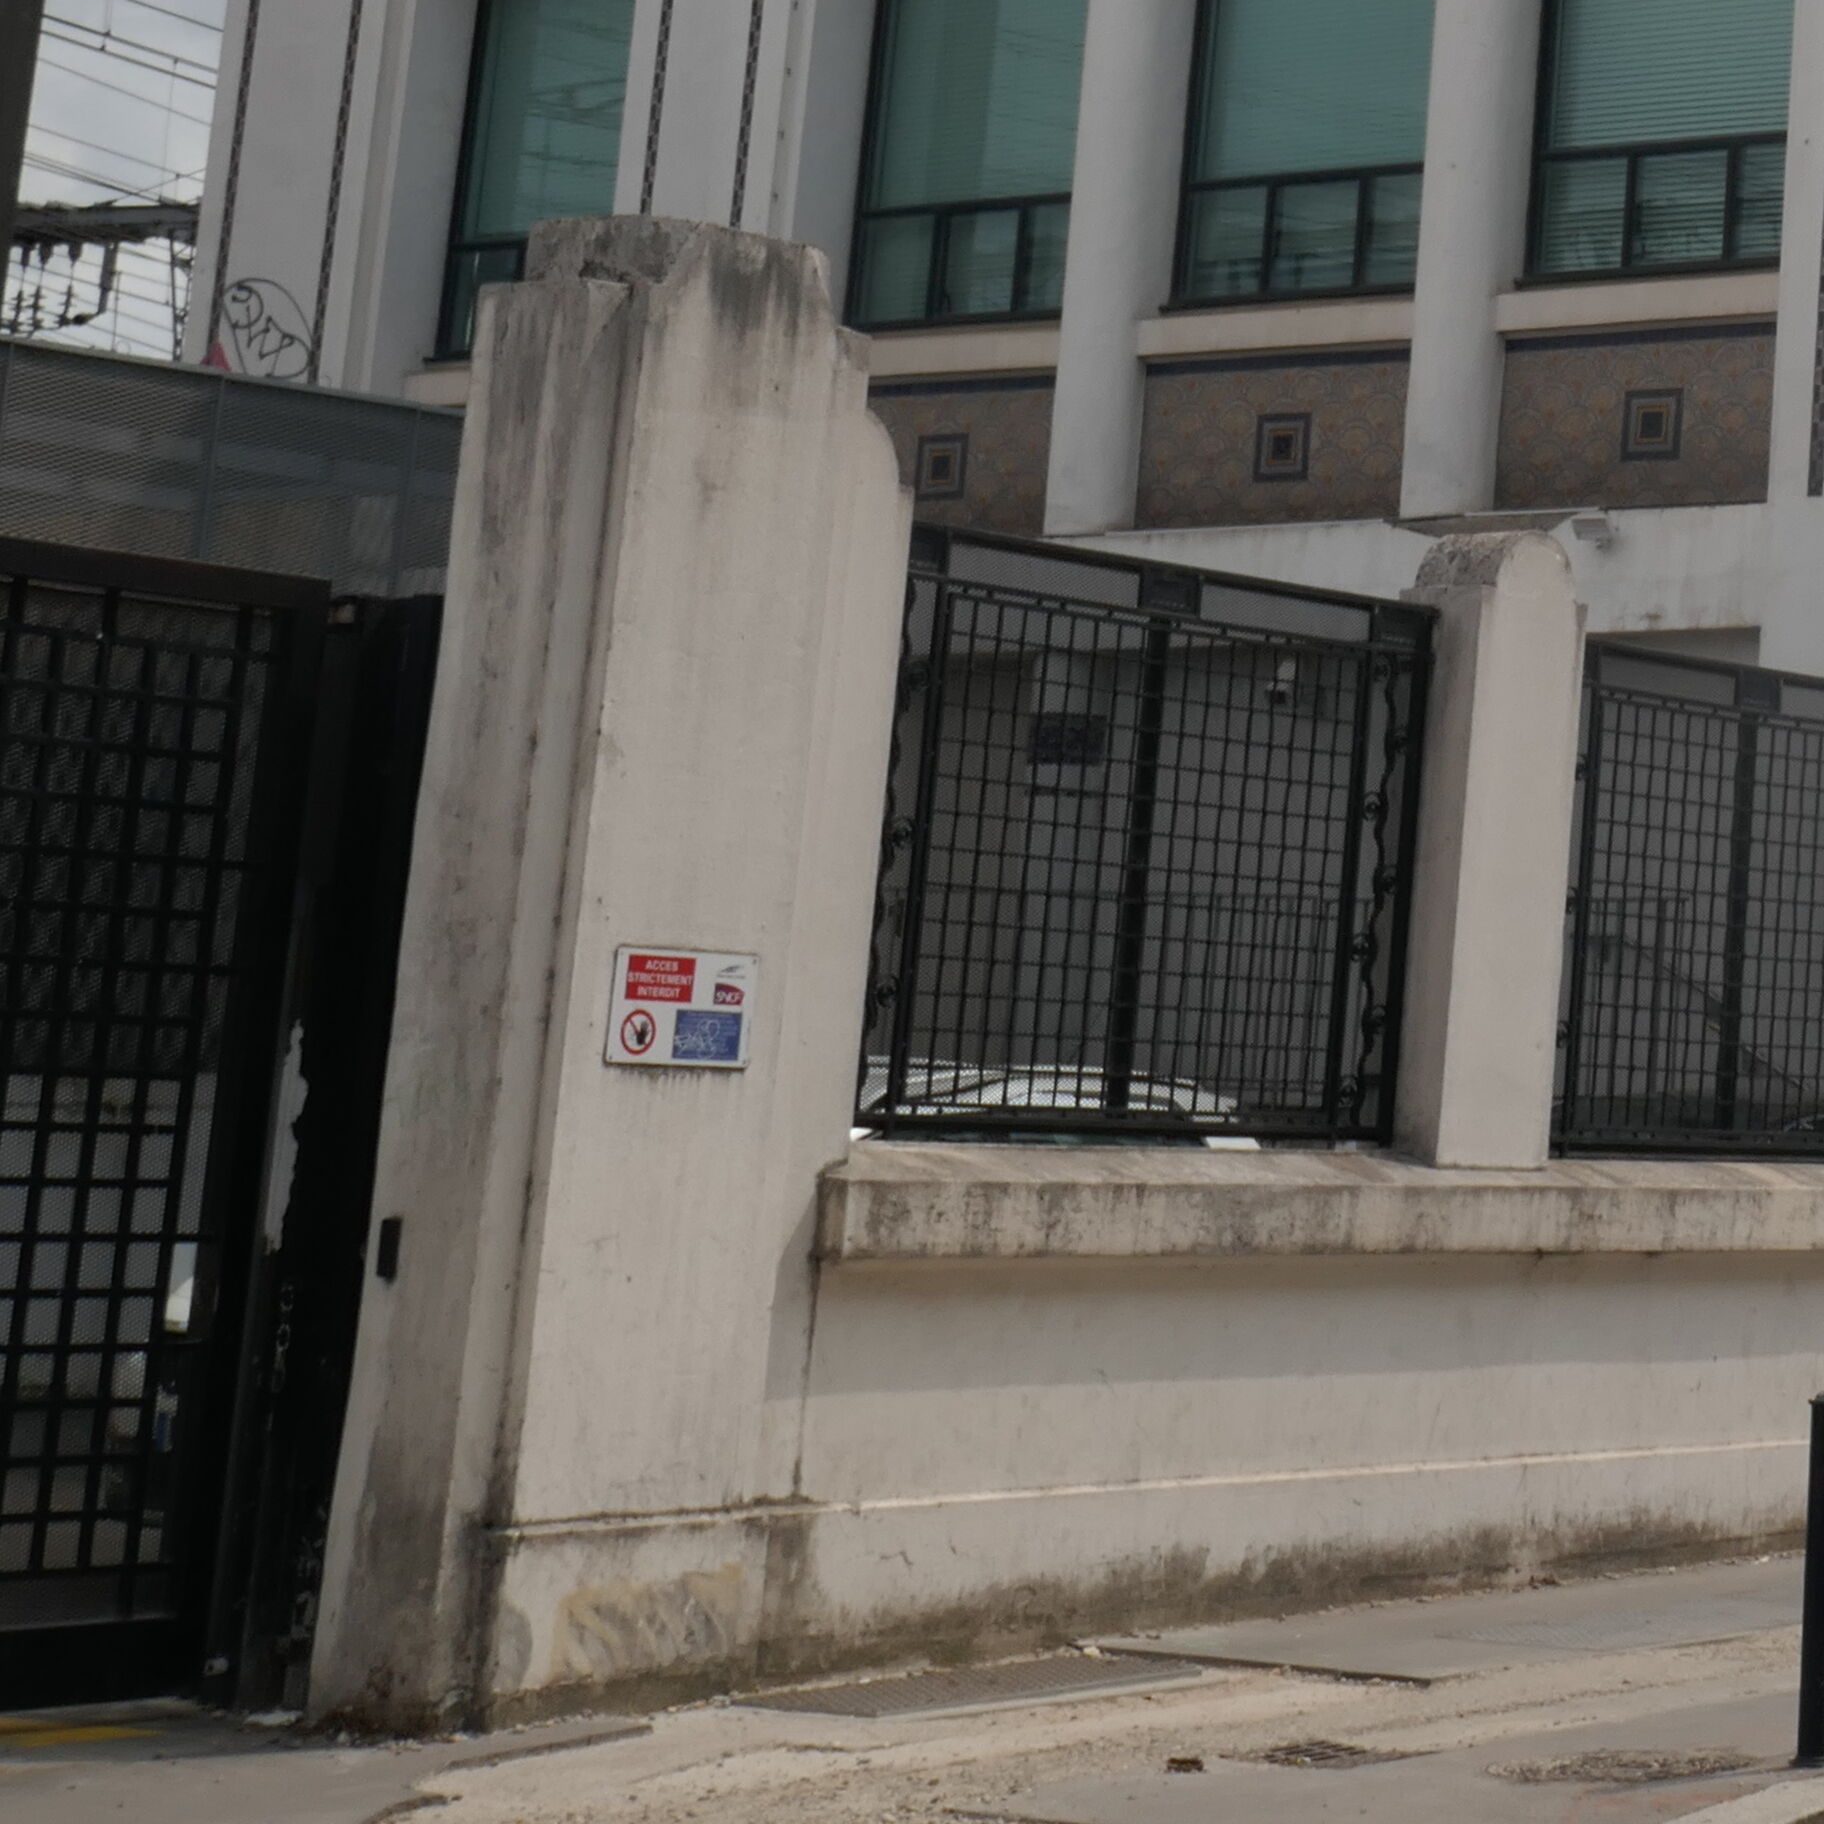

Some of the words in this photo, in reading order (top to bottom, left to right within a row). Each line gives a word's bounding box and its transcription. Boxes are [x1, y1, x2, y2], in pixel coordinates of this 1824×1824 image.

[627, 971, 694, 986] STRICTEMENT
[636, 985, 682, 999] INTERDIT
[715, 991, 742, 1005] SNCF
